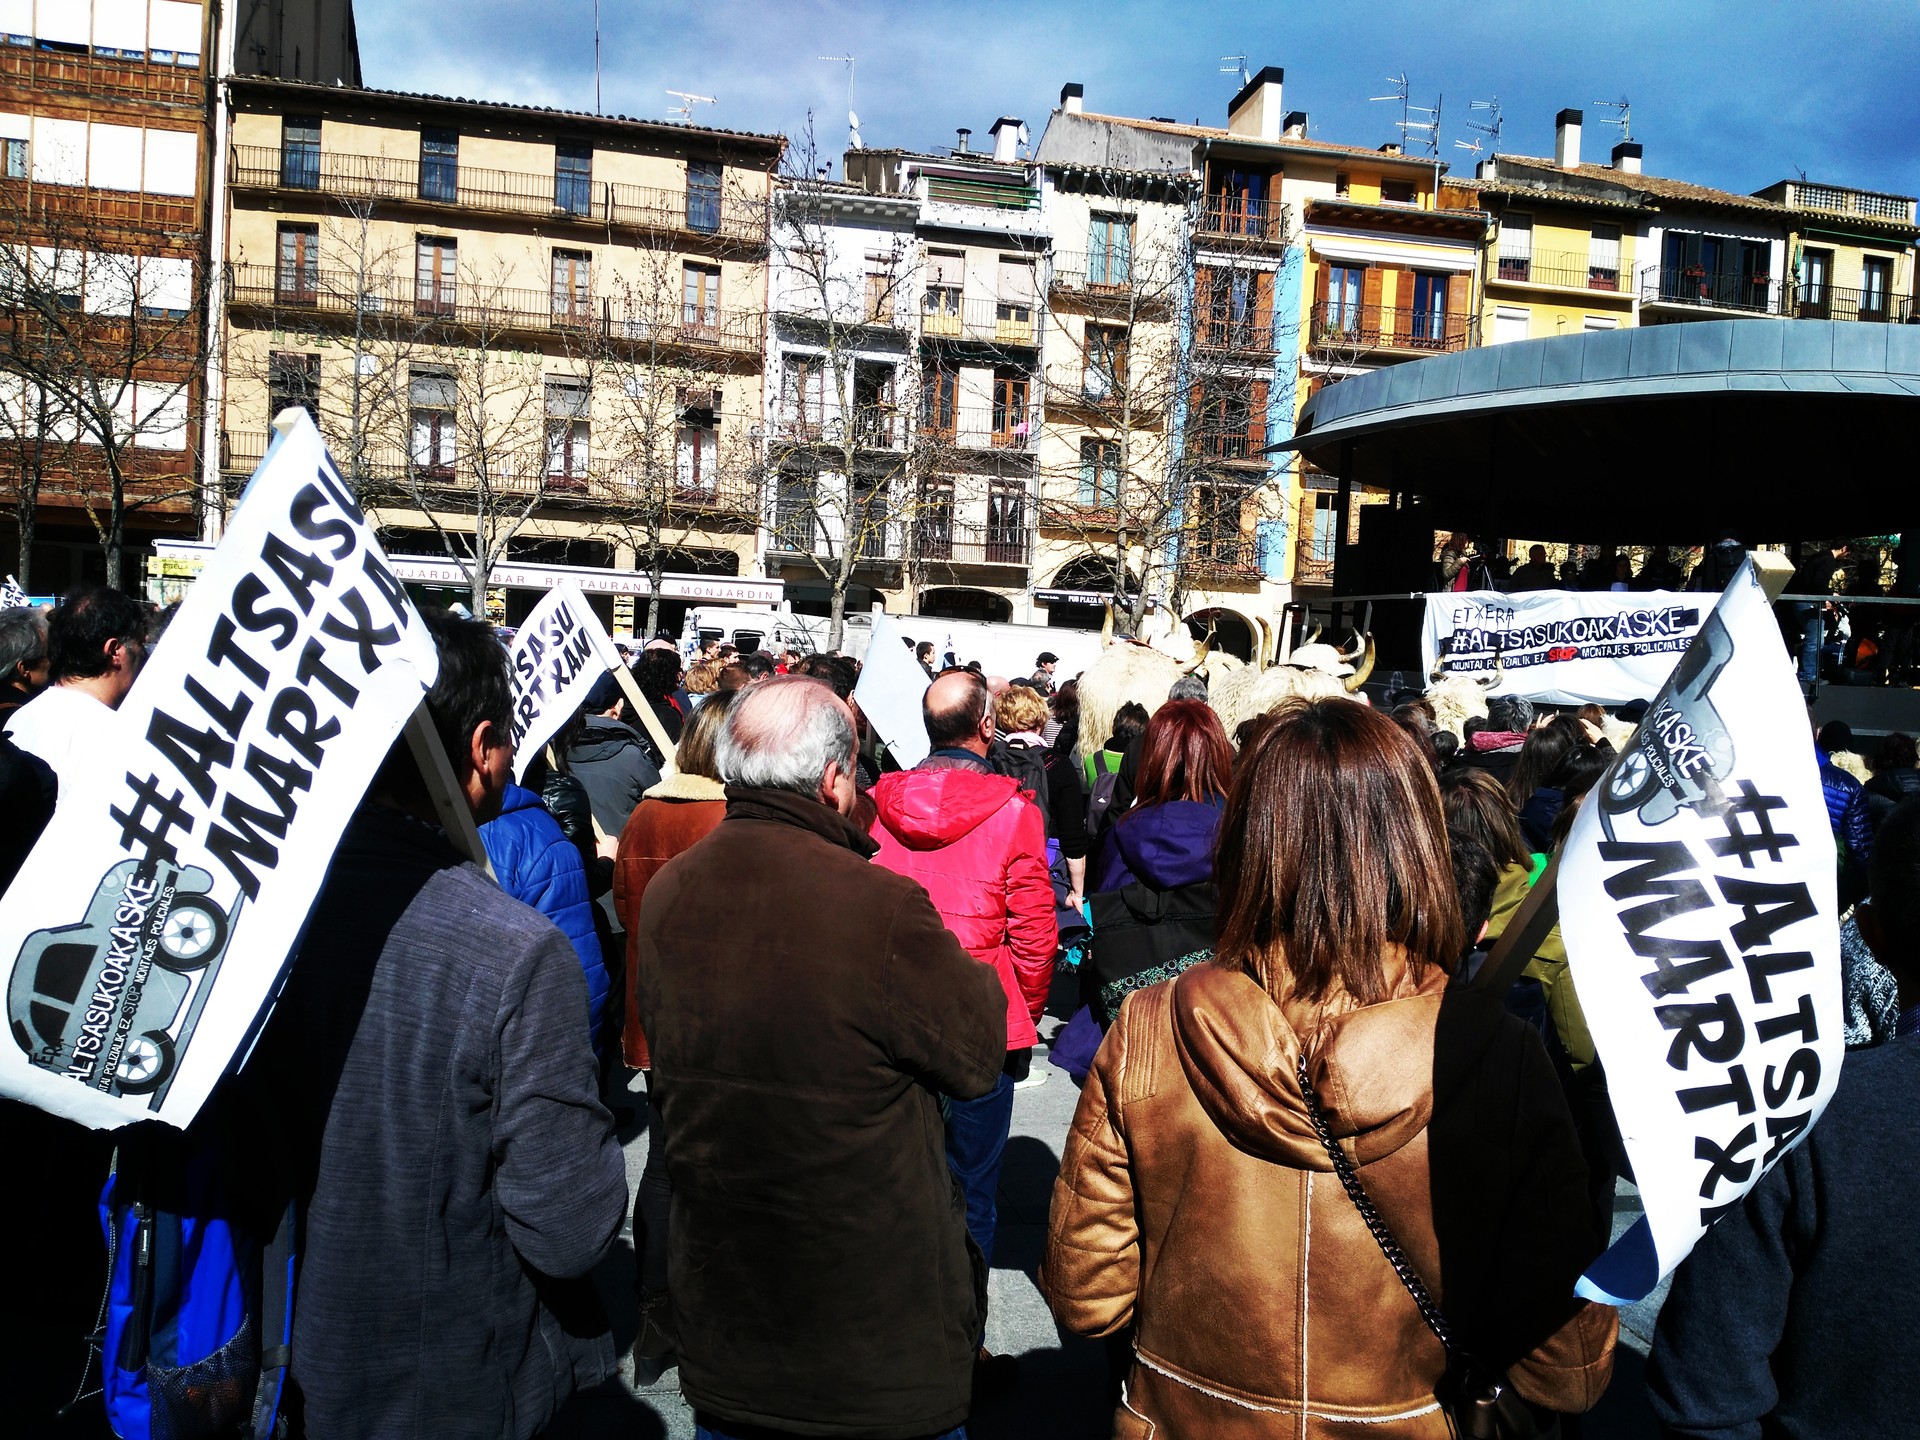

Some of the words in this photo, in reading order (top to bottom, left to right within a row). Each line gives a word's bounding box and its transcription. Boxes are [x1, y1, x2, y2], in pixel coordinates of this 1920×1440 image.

[494, 574, 525, 584] BAR
[680, 586, 773, 599] MONJARDIN
[1451, 606, 1685, 652] #ALTSASUKOAKASKE
[1453, 604, 1514, 624] ETXERA
[1534, 653, 1546, 664] EZ
[1548, 646, 1578, 662] STOP
[1581, 643, 1629, 658] MONTAJES
[1633, 639, 1693, 653] POLICIALES
[205, 548, 410, 902] MARTXA
[1644, 744, 1675, 789] POLICIALES
[151, 885, 176, 936] POLICIALES
[133, 938, 158, 985] MONTAJES
[123, 986, 141, 1015] STOP
[121, 1018, 132, 1031] EZ
[104, 1031, 127, 1077] POLIZIALIK
